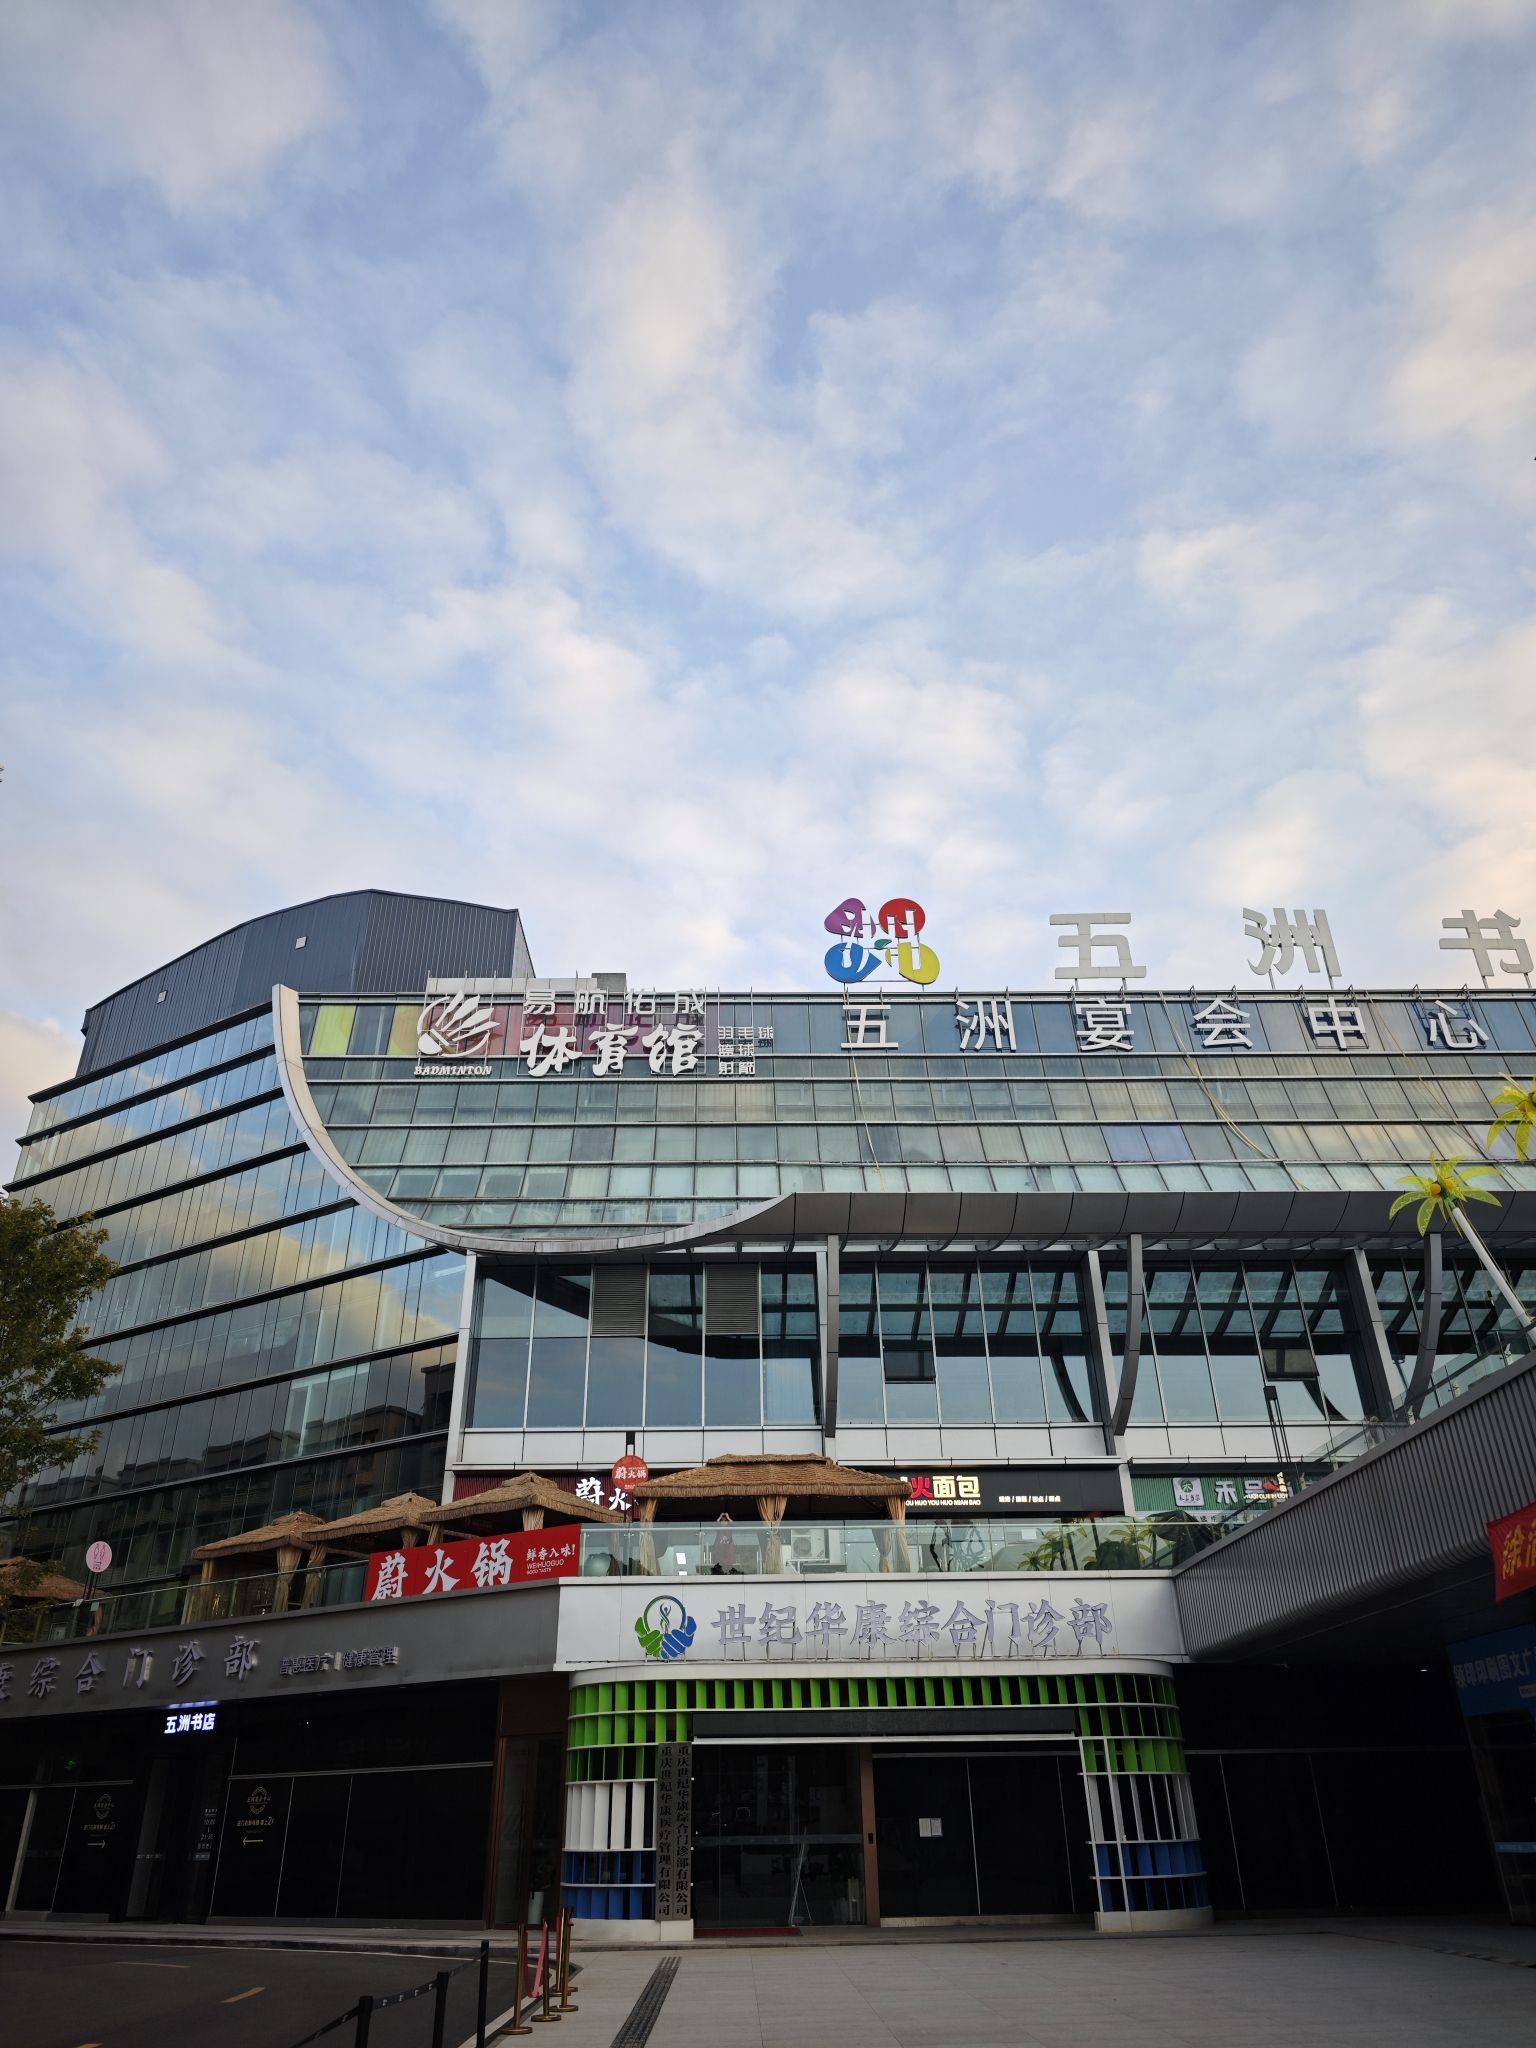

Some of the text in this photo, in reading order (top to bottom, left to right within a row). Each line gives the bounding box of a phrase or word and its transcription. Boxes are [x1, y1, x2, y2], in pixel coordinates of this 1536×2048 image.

[1049, 907, 1536, 979] 五洲书
[717, 1025, 774, 1040] 羽毛球
[840, 998, 1489, 1052] 五洲宴会中心
[519, 1023, 704, 1077] 体育馆
[718, 1043, 755, 1057] 篮球
[414, 1065, 493, 1077] BADMINTON
[575, 1476, 639, 1511] 蔚火
[899, 1475, 981, 1499] 火面包
[371, 1537, 514, 1601] 蔚火锅
[711, 1597, 1115, 1651] 世纪华康综合门诊部
[163, 1712, 217, 1735] 五洲书店
